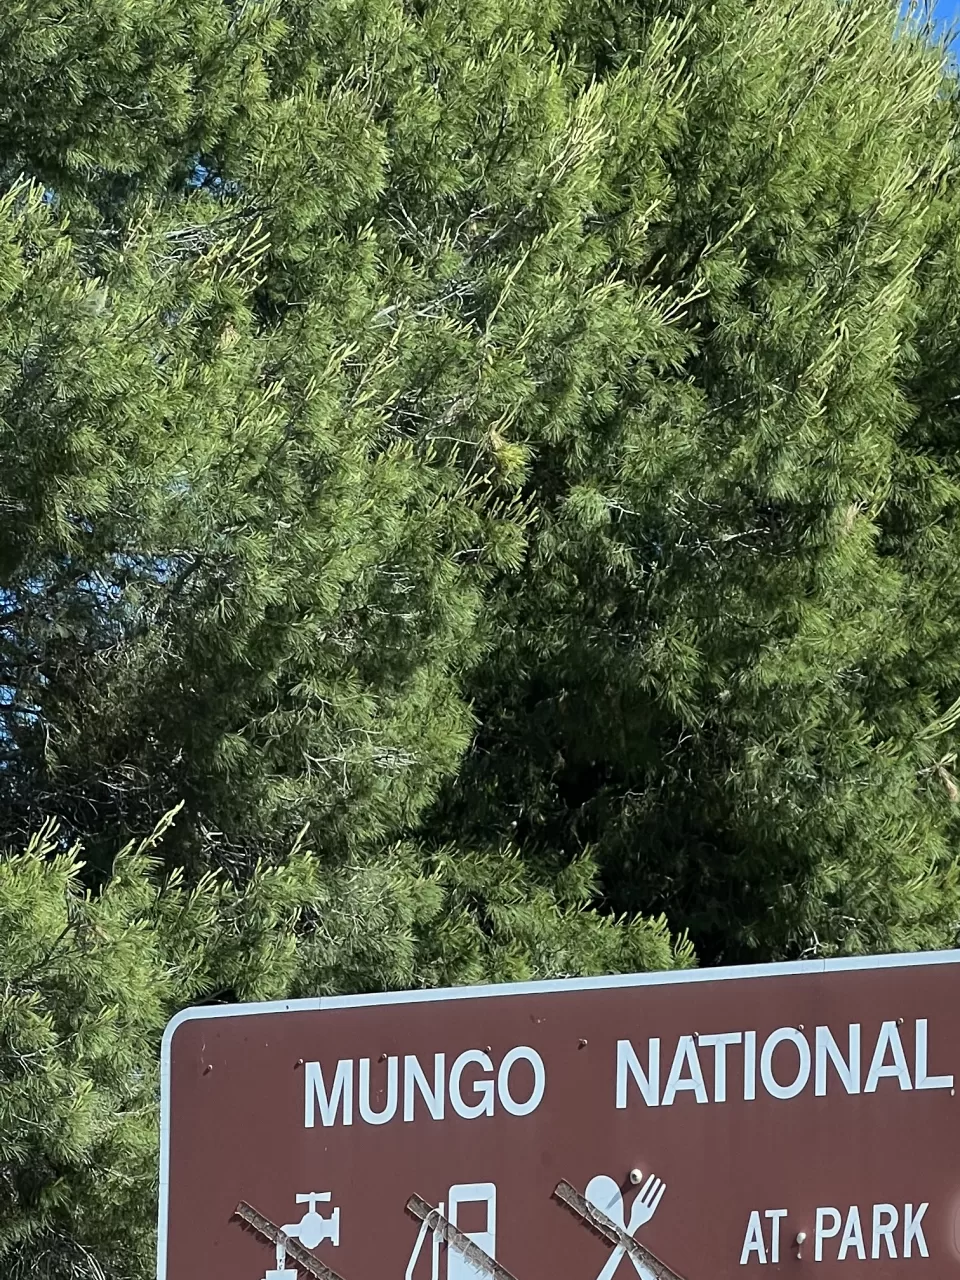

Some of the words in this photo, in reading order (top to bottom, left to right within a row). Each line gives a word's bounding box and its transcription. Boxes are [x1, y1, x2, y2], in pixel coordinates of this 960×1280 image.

[303, 1045, 547, 1128] MUNGO
[614, 1018, 955, 1110] NATIONAL
[738, 1208, 789, 1266] AT
[813, 1202, 931, 1263] PARK
